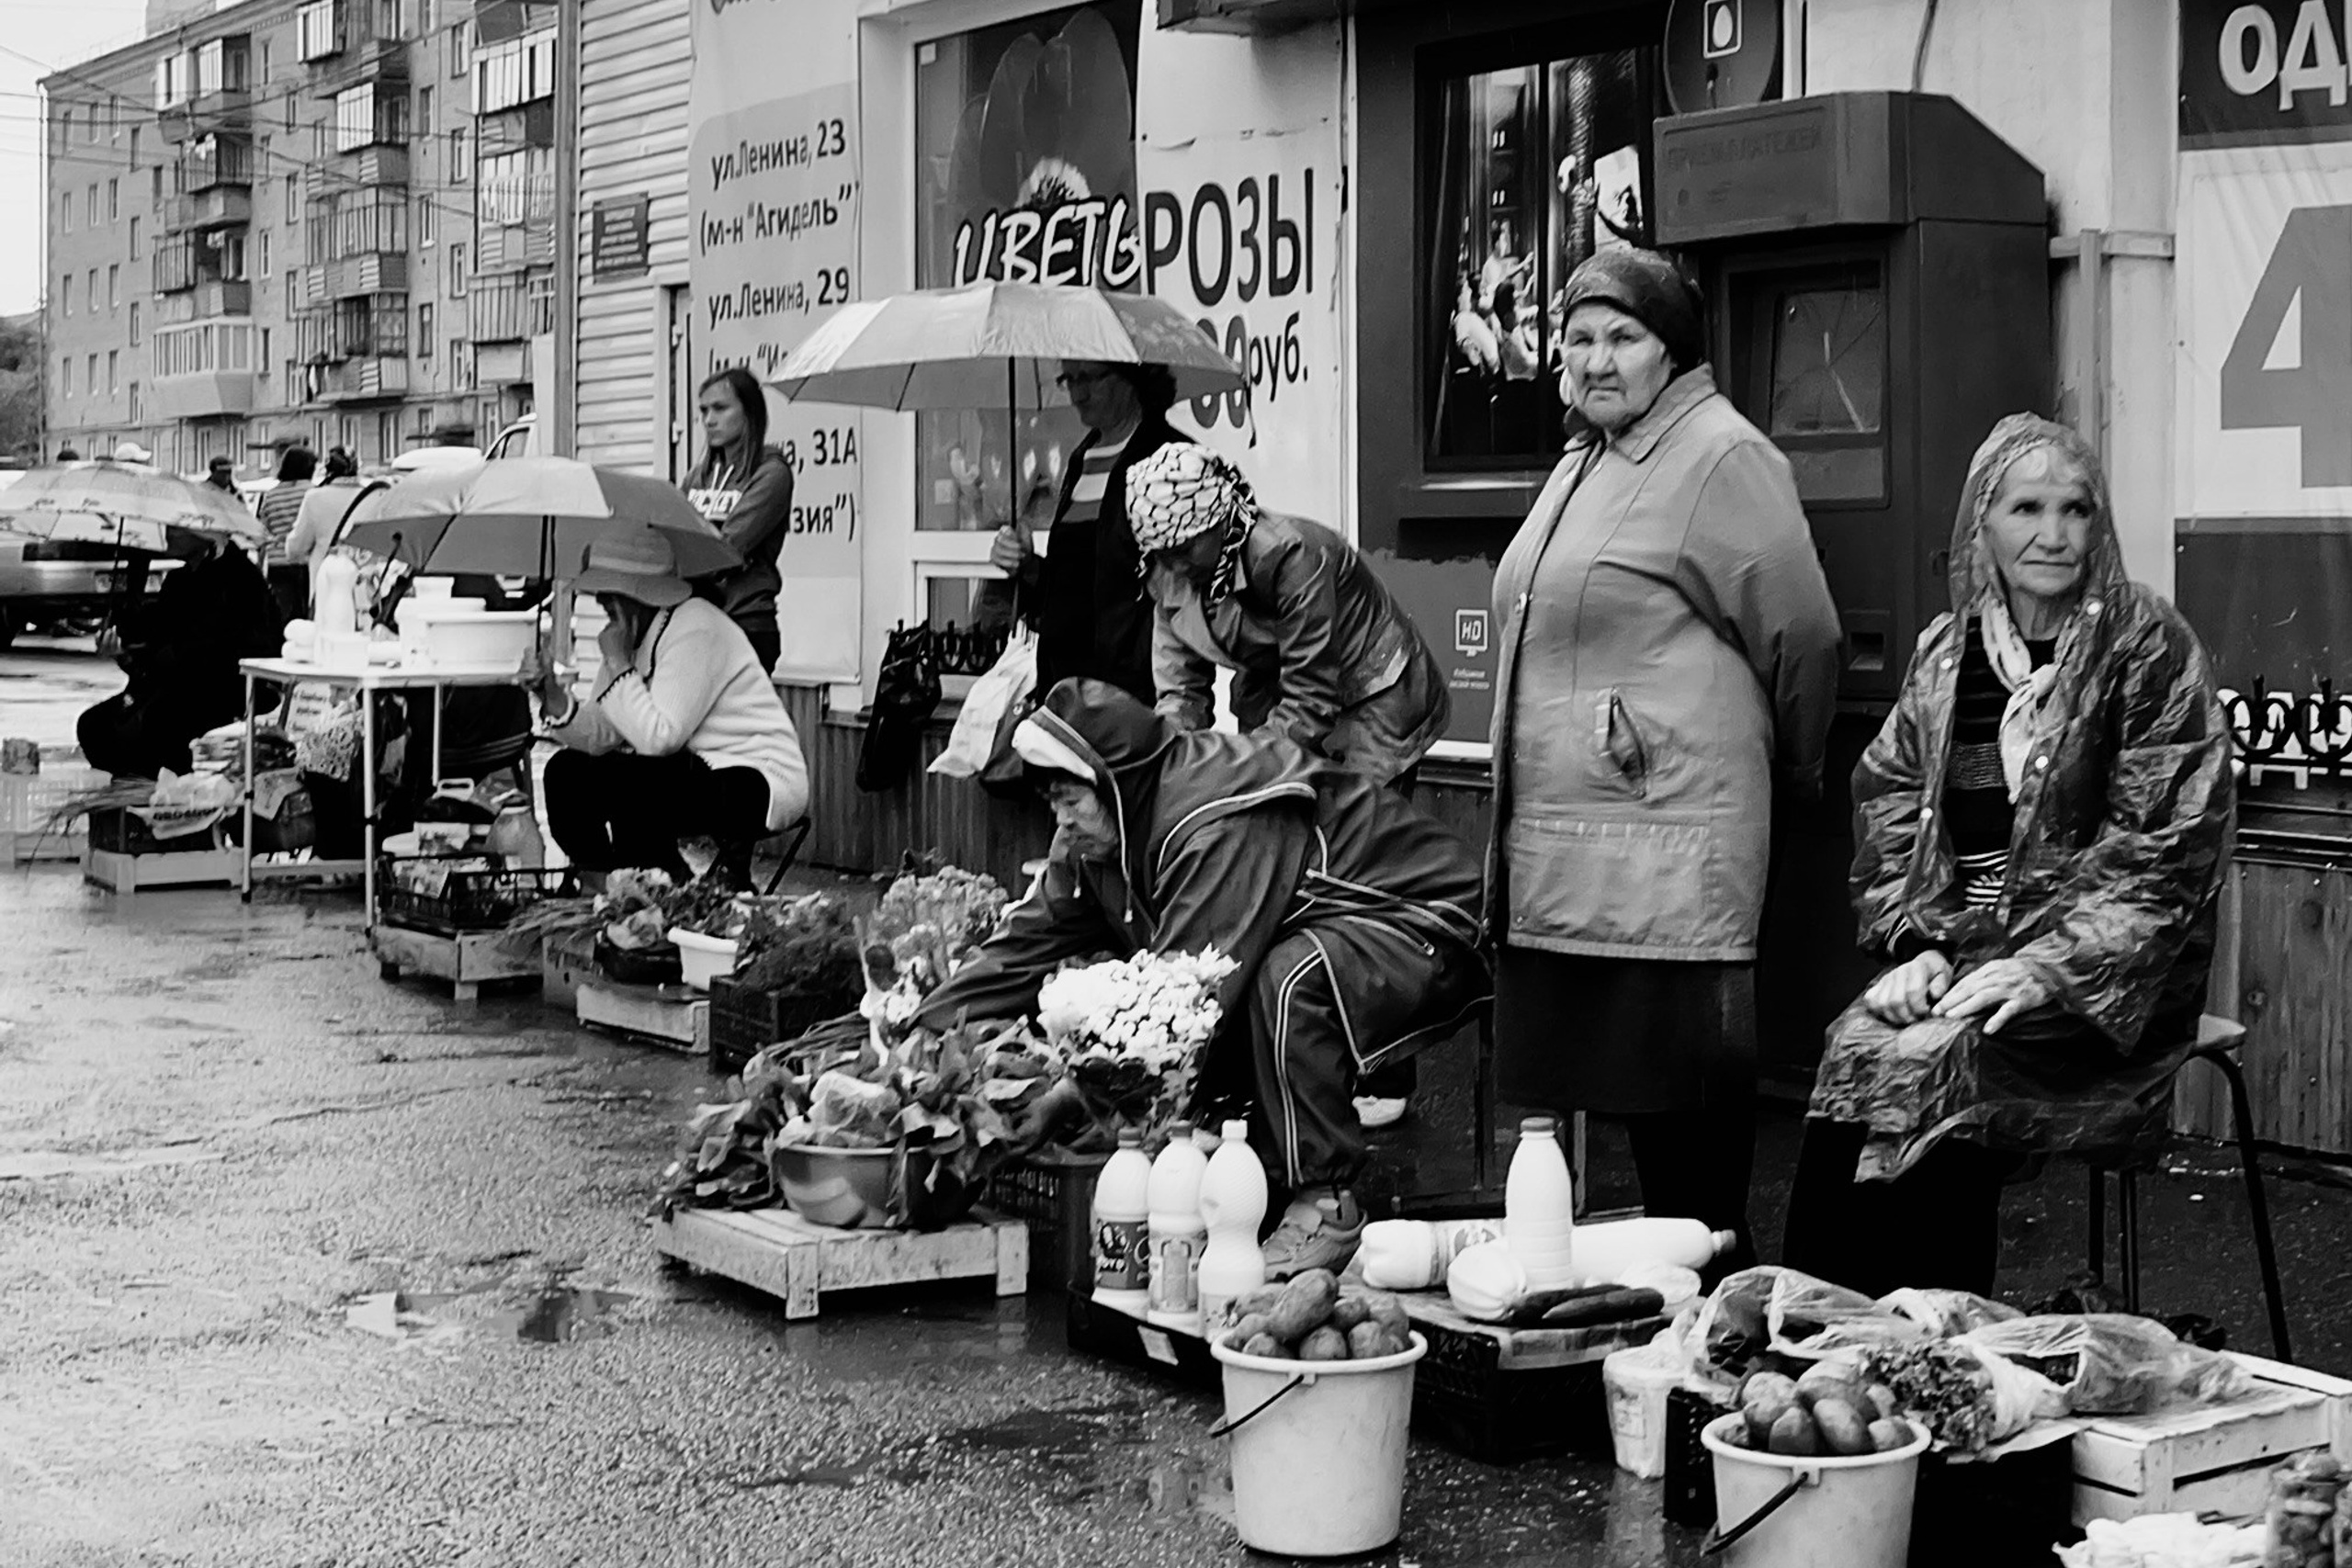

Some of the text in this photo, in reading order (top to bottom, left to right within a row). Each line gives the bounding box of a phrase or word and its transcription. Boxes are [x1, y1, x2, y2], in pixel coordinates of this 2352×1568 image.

[2219, 0, 2352, 111] ОД
[817, 118, 846, 159] 23
[1145, 167, 1314, 306] РОЗЫ
[817, 265, 850, 306] 29
[813, 426, 857, 466] 31А
